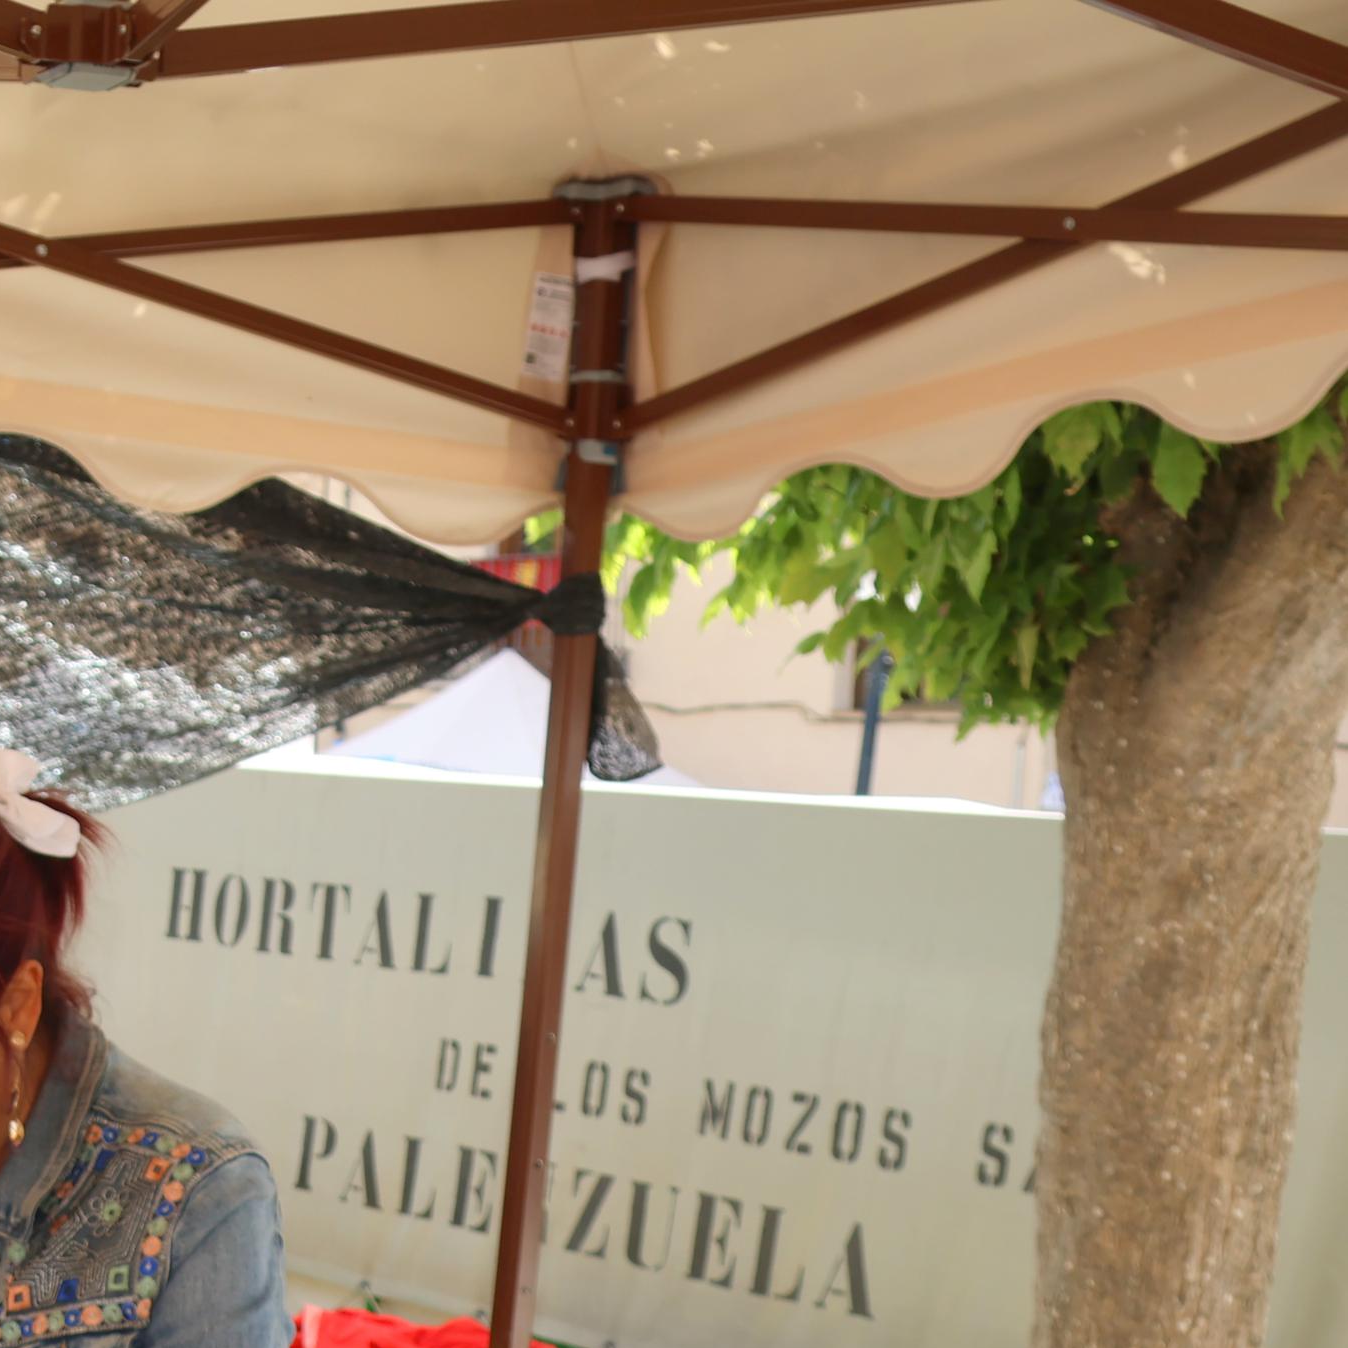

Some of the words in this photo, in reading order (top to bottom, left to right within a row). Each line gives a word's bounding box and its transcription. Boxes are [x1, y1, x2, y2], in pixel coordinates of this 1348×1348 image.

[166, 866, 693, 1006] HORTALIAS
[435, 1037, 499, 1100] DE
[551, 1058, 652, 1126] OS
[697, 1077, 913, 1173] MOZOS
[294, 1114, 876, 1321] PALEZUELA
